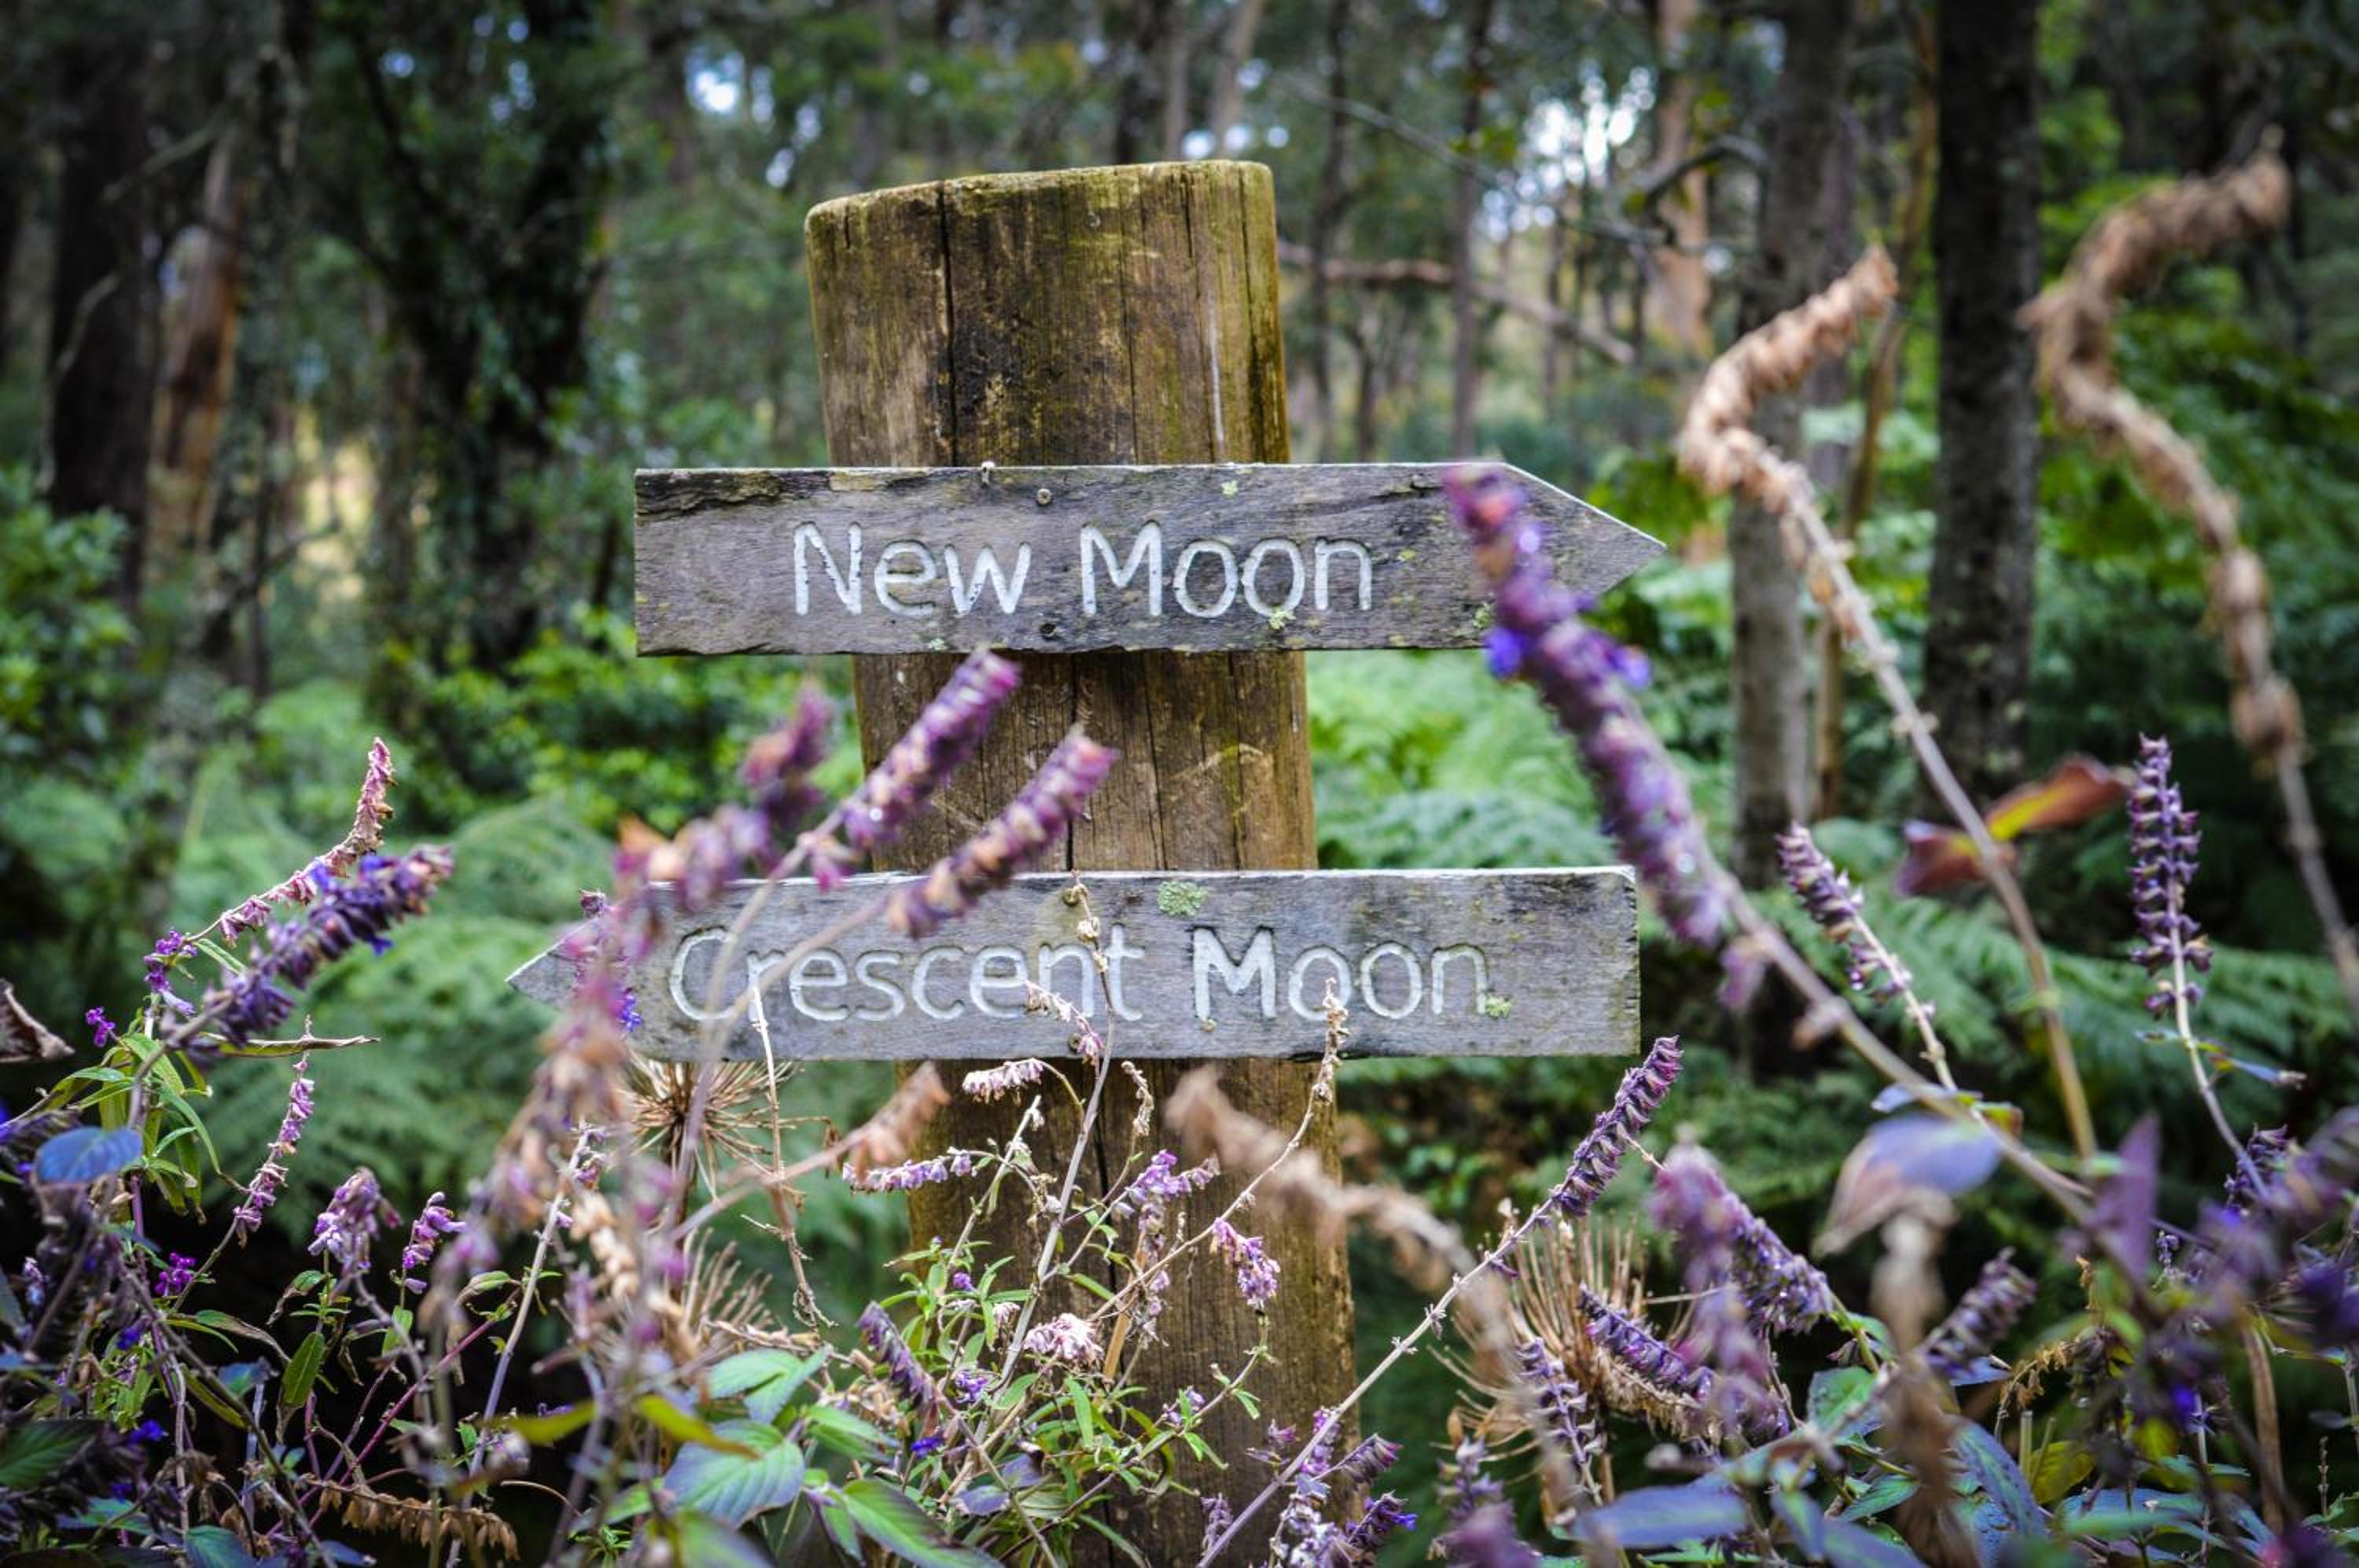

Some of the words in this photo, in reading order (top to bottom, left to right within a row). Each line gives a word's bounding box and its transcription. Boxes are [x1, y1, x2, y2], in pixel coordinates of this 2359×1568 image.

[793, 521, 1032, 617] New
[1080, 520, 1373, 618] Moon
[668, 923, 1146, 1023] Crescent
[1191, 926, 1489, 1021] Moon
